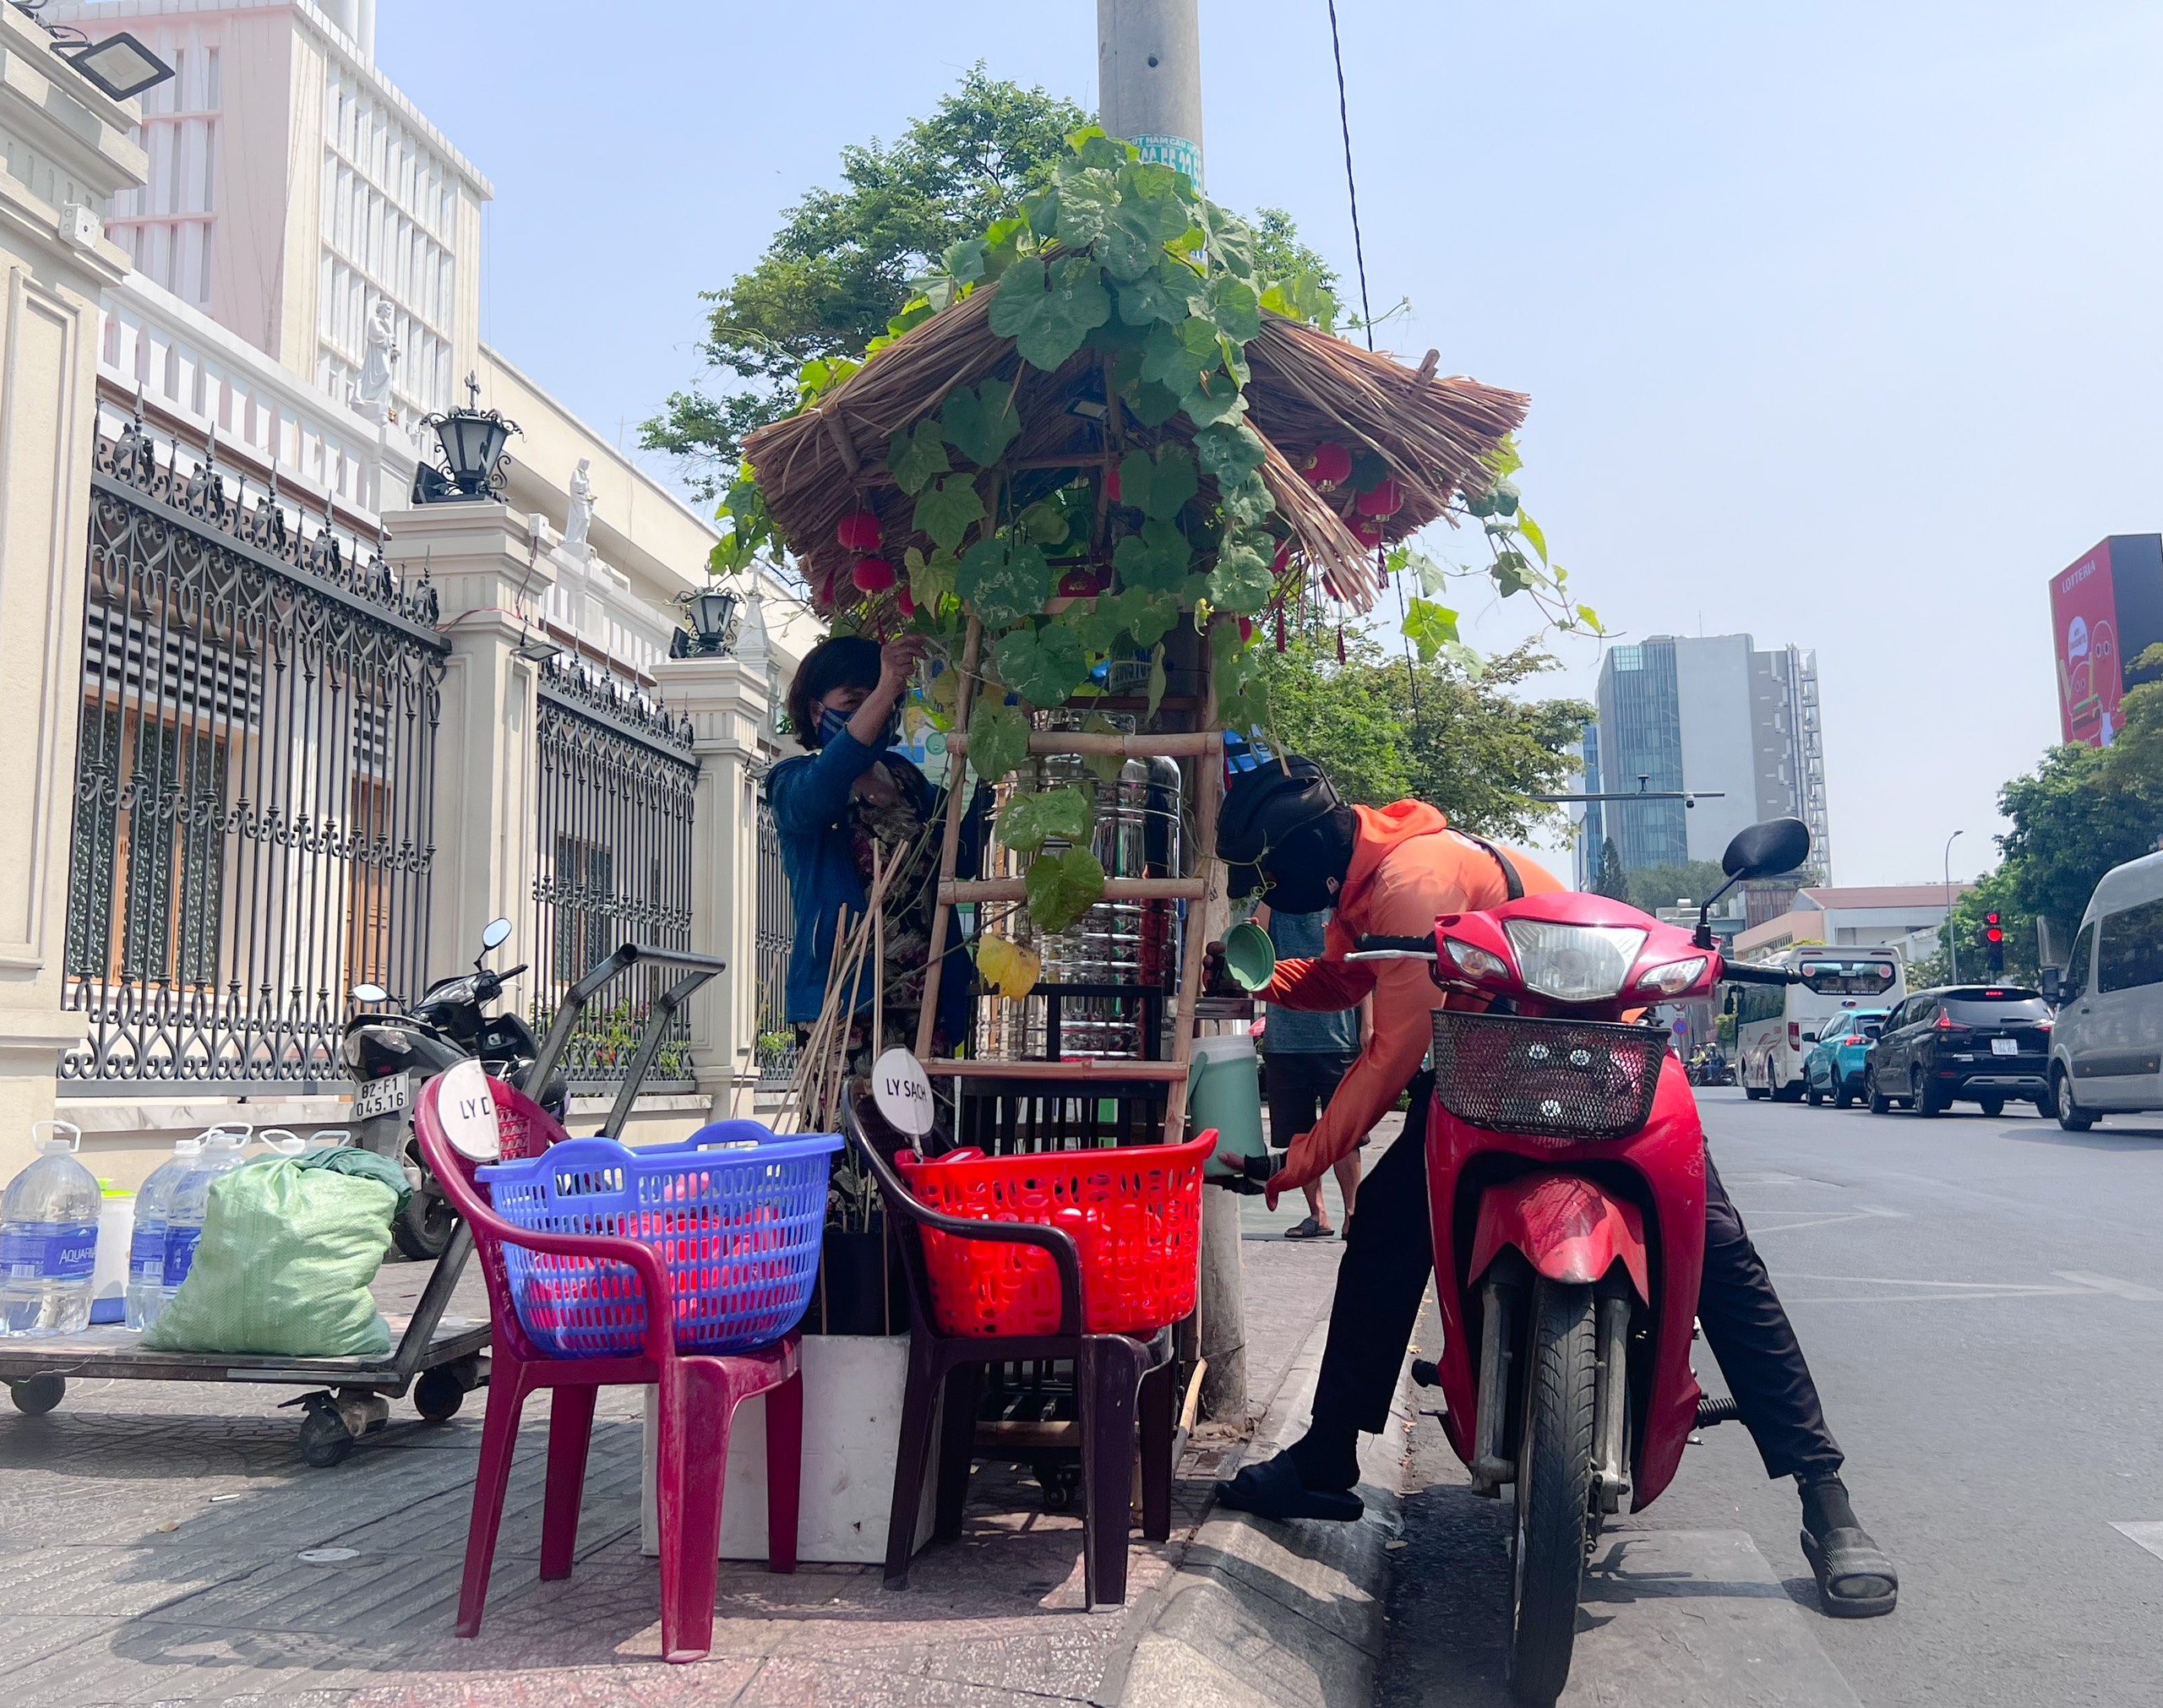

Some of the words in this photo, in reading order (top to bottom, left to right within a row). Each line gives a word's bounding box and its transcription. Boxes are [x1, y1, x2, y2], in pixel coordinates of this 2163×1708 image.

[2062, 559, 2096, 595] LOTTERIA
[362, 1076, 397, 1099] 82-F1
[885, 1078, 900, 1096] LY
[903, 1080, 927, 1102] SẠCH
[357, 1091, 404, 1117] 045.16
[460, 1097, 476, 1119] LY
